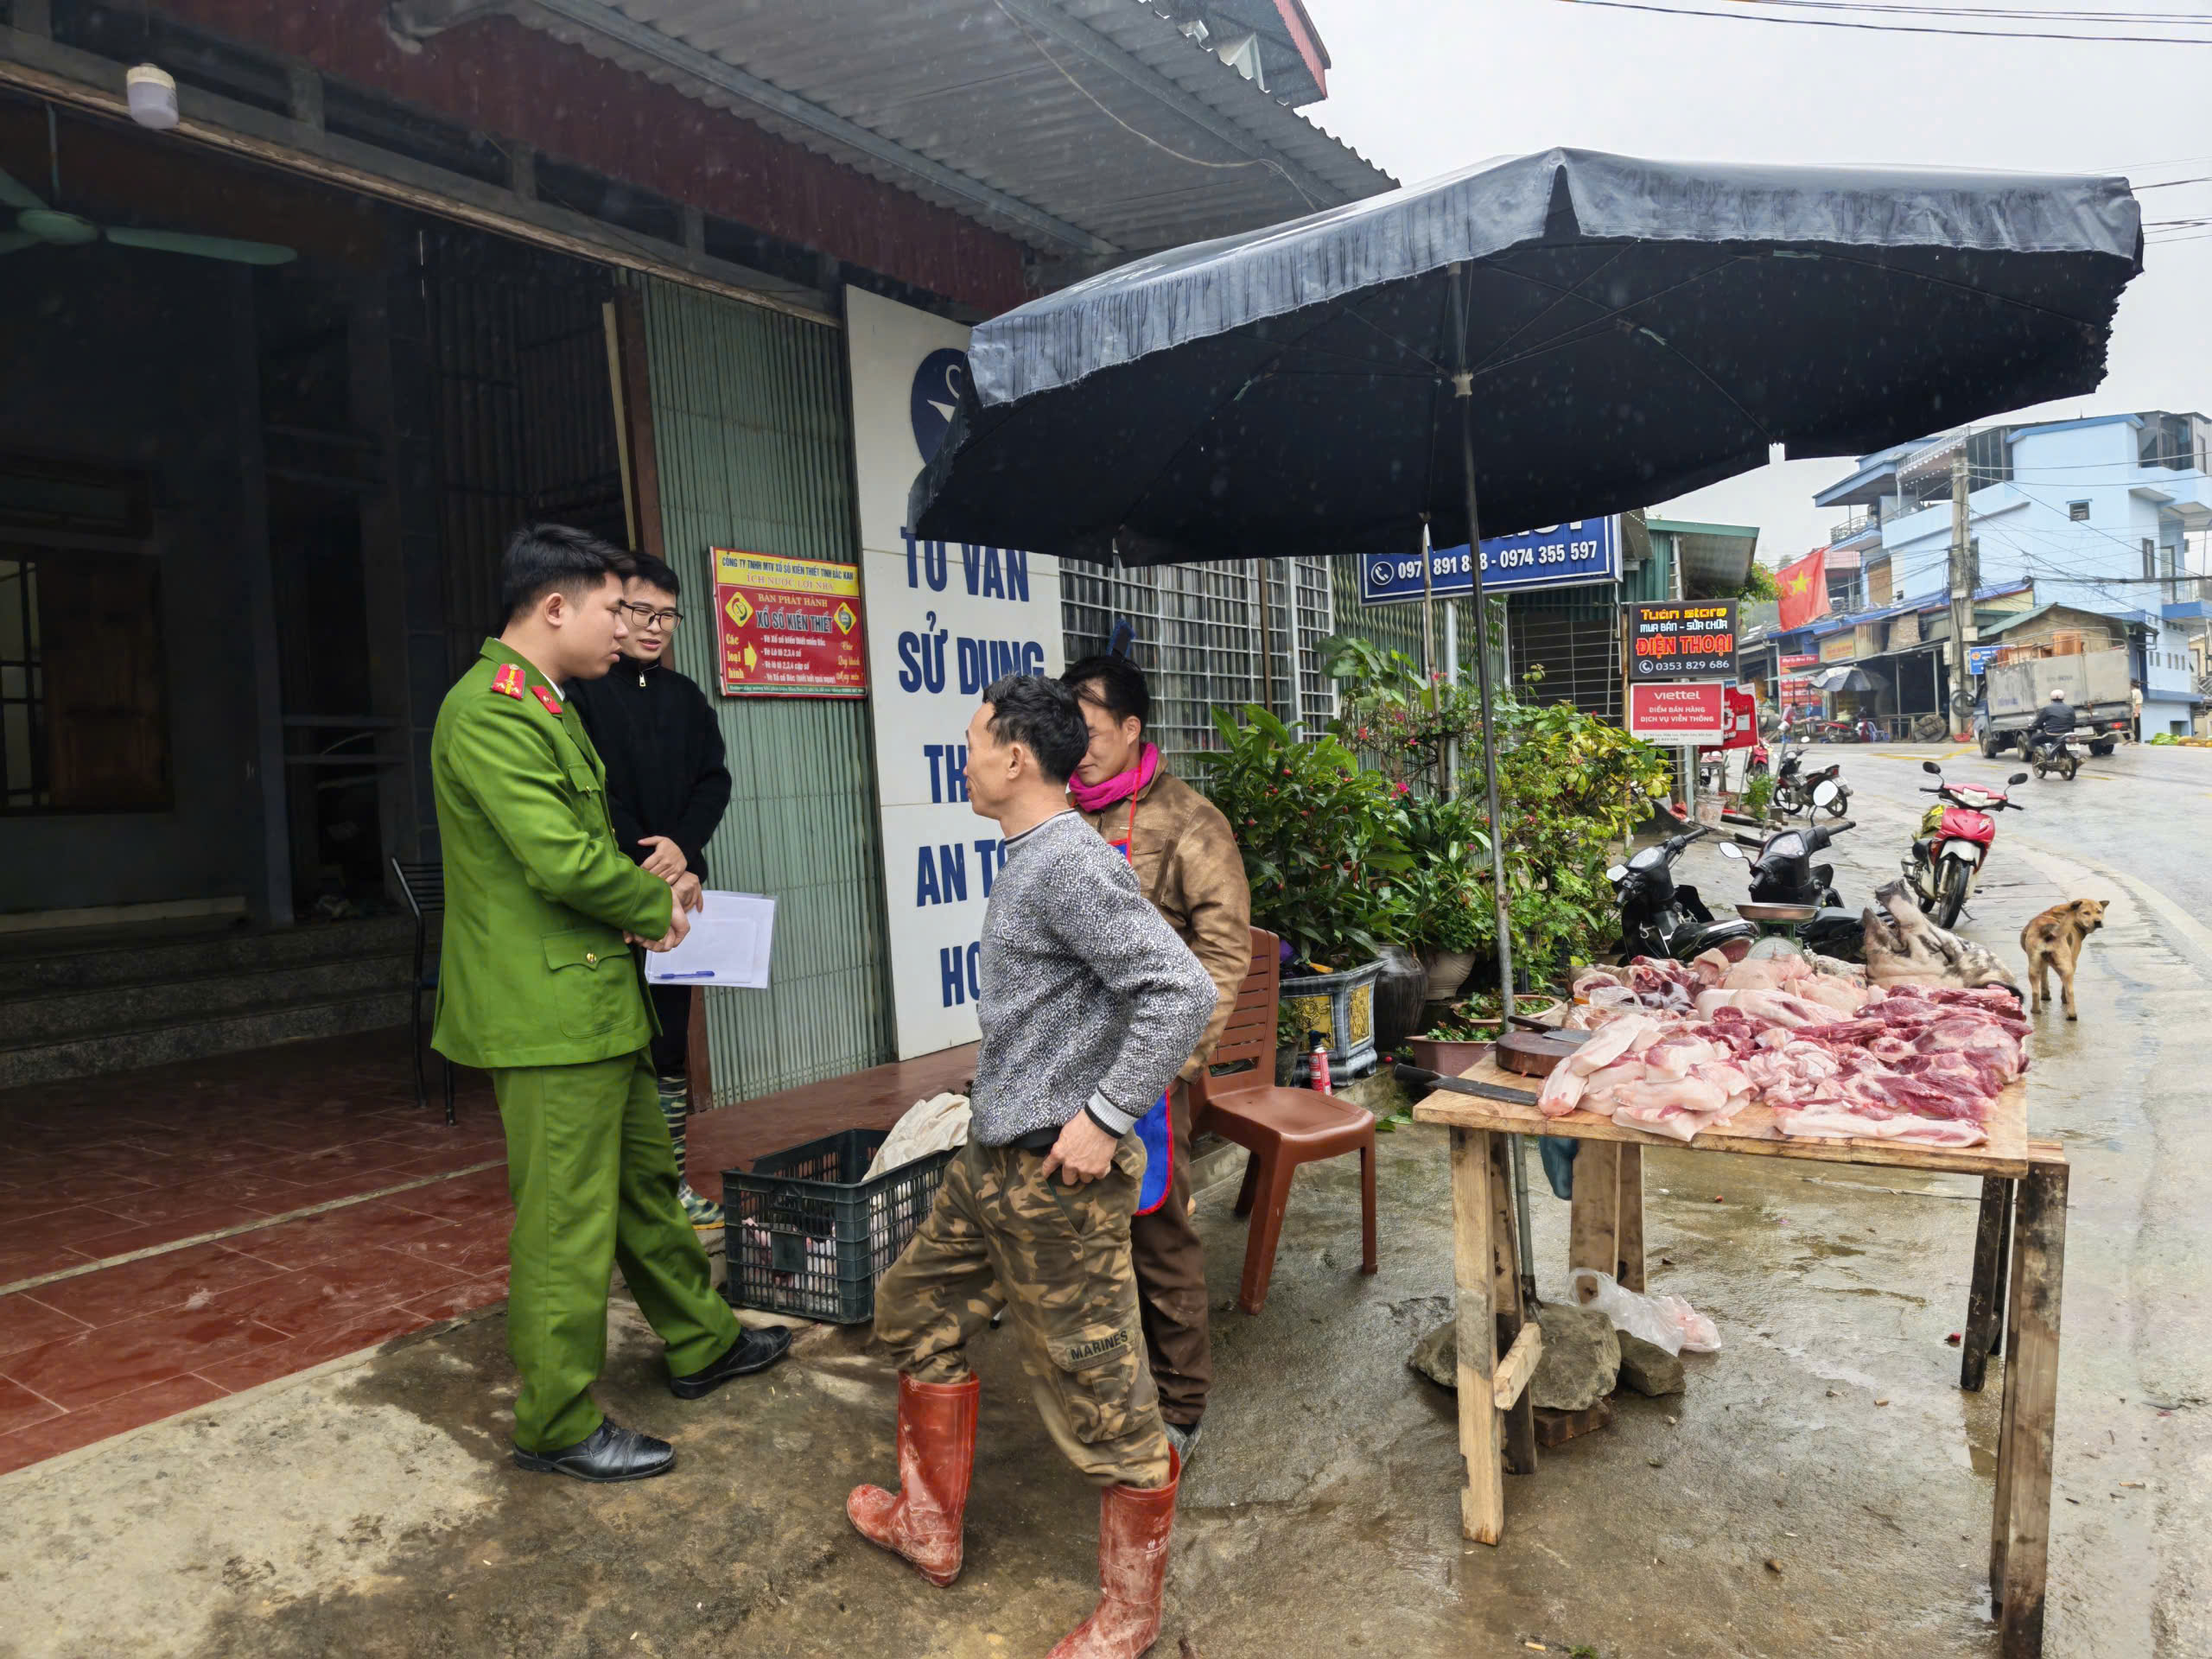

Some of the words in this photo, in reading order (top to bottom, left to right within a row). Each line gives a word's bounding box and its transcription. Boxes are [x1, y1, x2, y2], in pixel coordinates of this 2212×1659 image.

[740, 559, 746, 568] TY
[763, 562, 774, 571] MTV
[1398, 561, 1423, 579] 097
[1433, 556, 1457, 575] 891
[1461, 553, 1488, 573] 88
[1500, 548, 1534, 568] 0974
[1538, 543, 1565, 563] 355
[1570, 540, 1597, 560] 597
[772, 607, 785, 630] SỐ
[786, 608, 809, 632] KIẾN
[810, 611, 833, 633] THIẾT
[1640, 624, 1658, 632] MUA
[1660, 621, 1677, 632] BÁN
[899, 611, 948, 694] SỬ
[1636, 633, 1676, 659] ĐIỆN
[1679, 633, 1732, 657] THOẠI
[1656, 662, 1681, 671] 0353
[1686, 661, 1706, 670] 829
[1709, 660, 1729, 669] 686
[1654, 690, 1700, 701] viettel
[924, 745, 969, 804] TH
[917, 843, 967, 907] AN
[1071, 1331, 1128, 1360] MARINES
